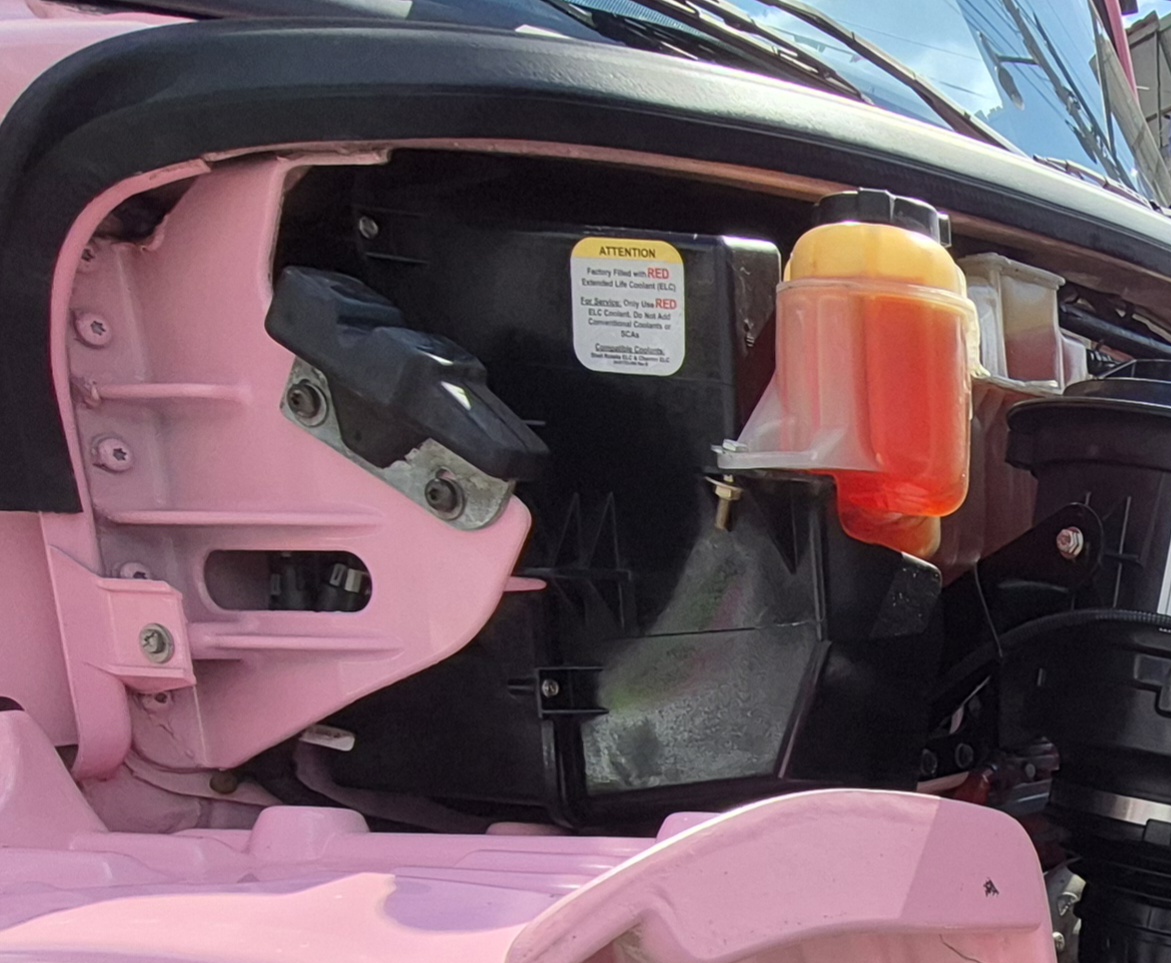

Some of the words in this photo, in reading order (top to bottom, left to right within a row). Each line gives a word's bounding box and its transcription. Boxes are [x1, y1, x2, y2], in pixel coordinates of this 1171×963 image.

[599, 246, 656, 258] ATTENTION
[587, 267, 611, 277] Factory
[614, 269, 631, 277] Filled
[633, 270, 646, 278] with
[648, 268, 669, 279] RED
[581, 278, 613, 287] Extended
[615, 280, 627, 288] Life
[630, 282, 655, 290] Coolant
[657, 283, 676, 292] (ELC)
[580, 297, 592, 305] For
[624, 299, 639, 309] Only
[655, 298, 677, 309] RED
[588, 319, 631, 327] Conventional
